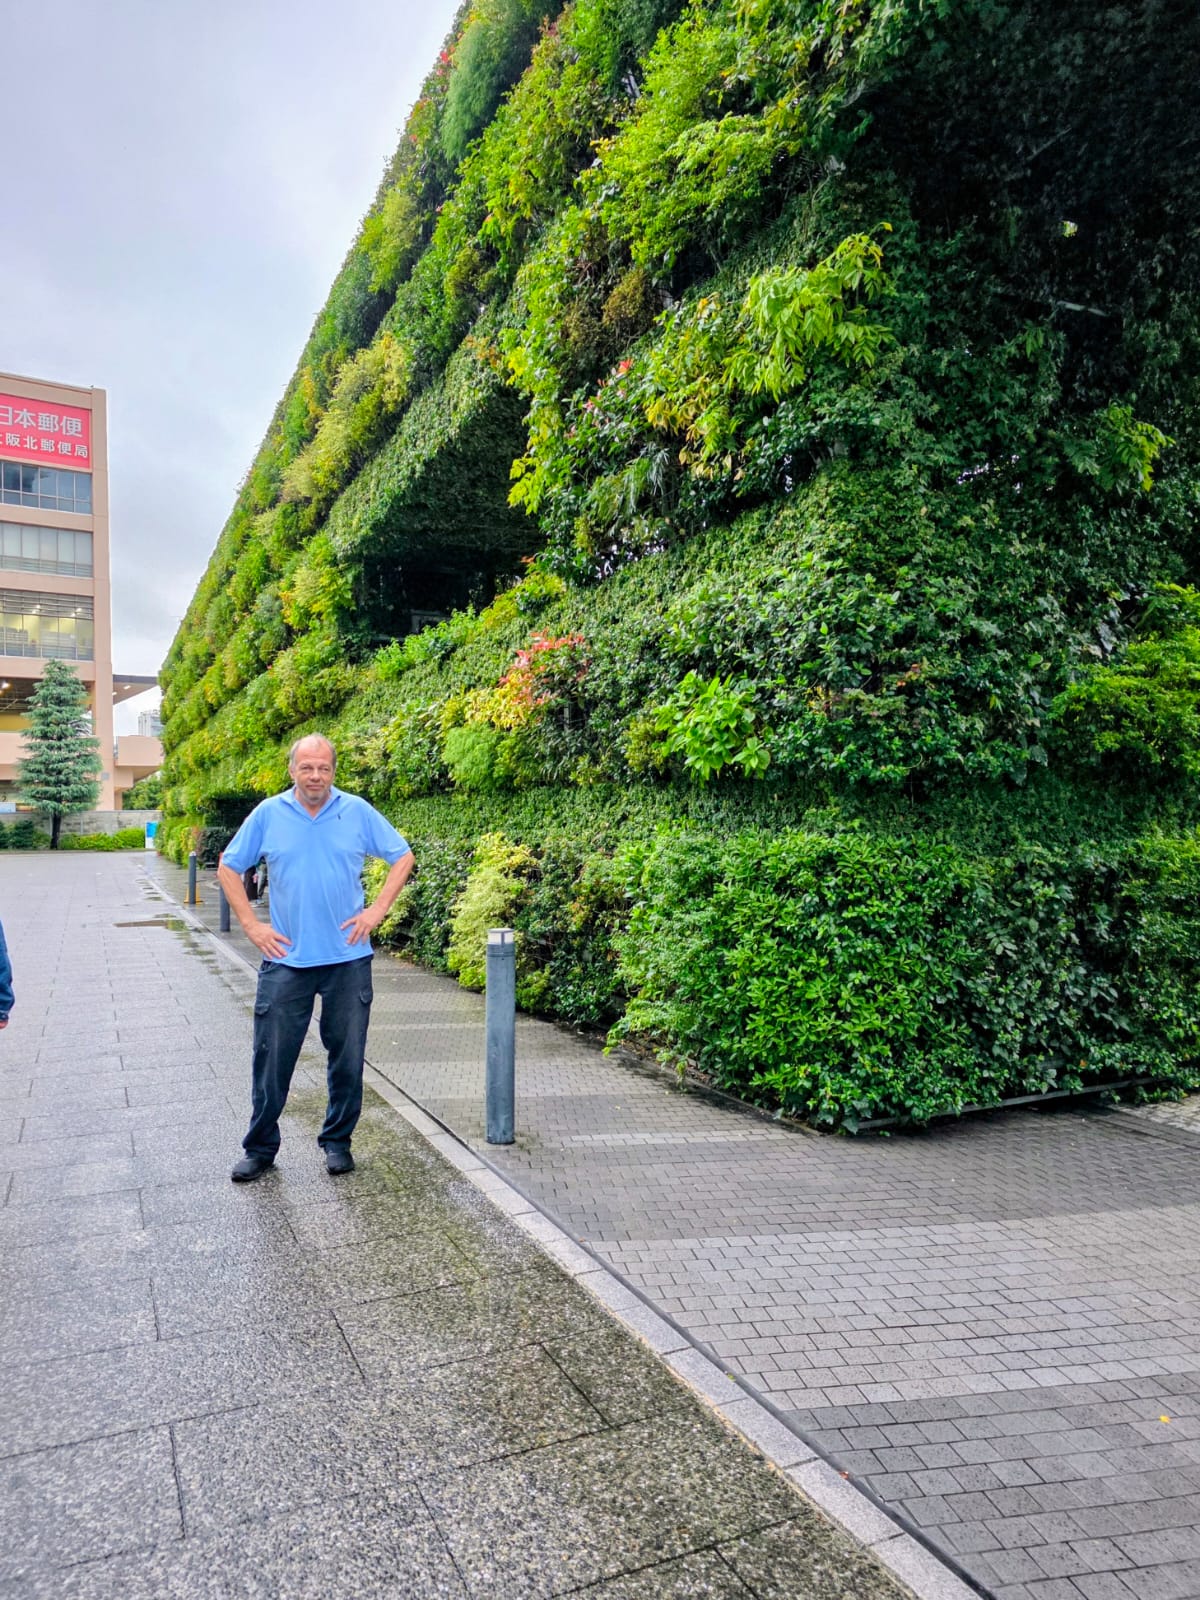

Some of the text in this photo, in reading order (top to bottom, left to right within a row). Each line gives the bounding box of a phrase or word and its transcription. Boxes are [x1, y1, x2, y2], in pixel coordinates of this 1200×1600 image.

[0, 405, 83, 437] 日本郵便
[0, 433, 88, 458] 阪北郵便局
